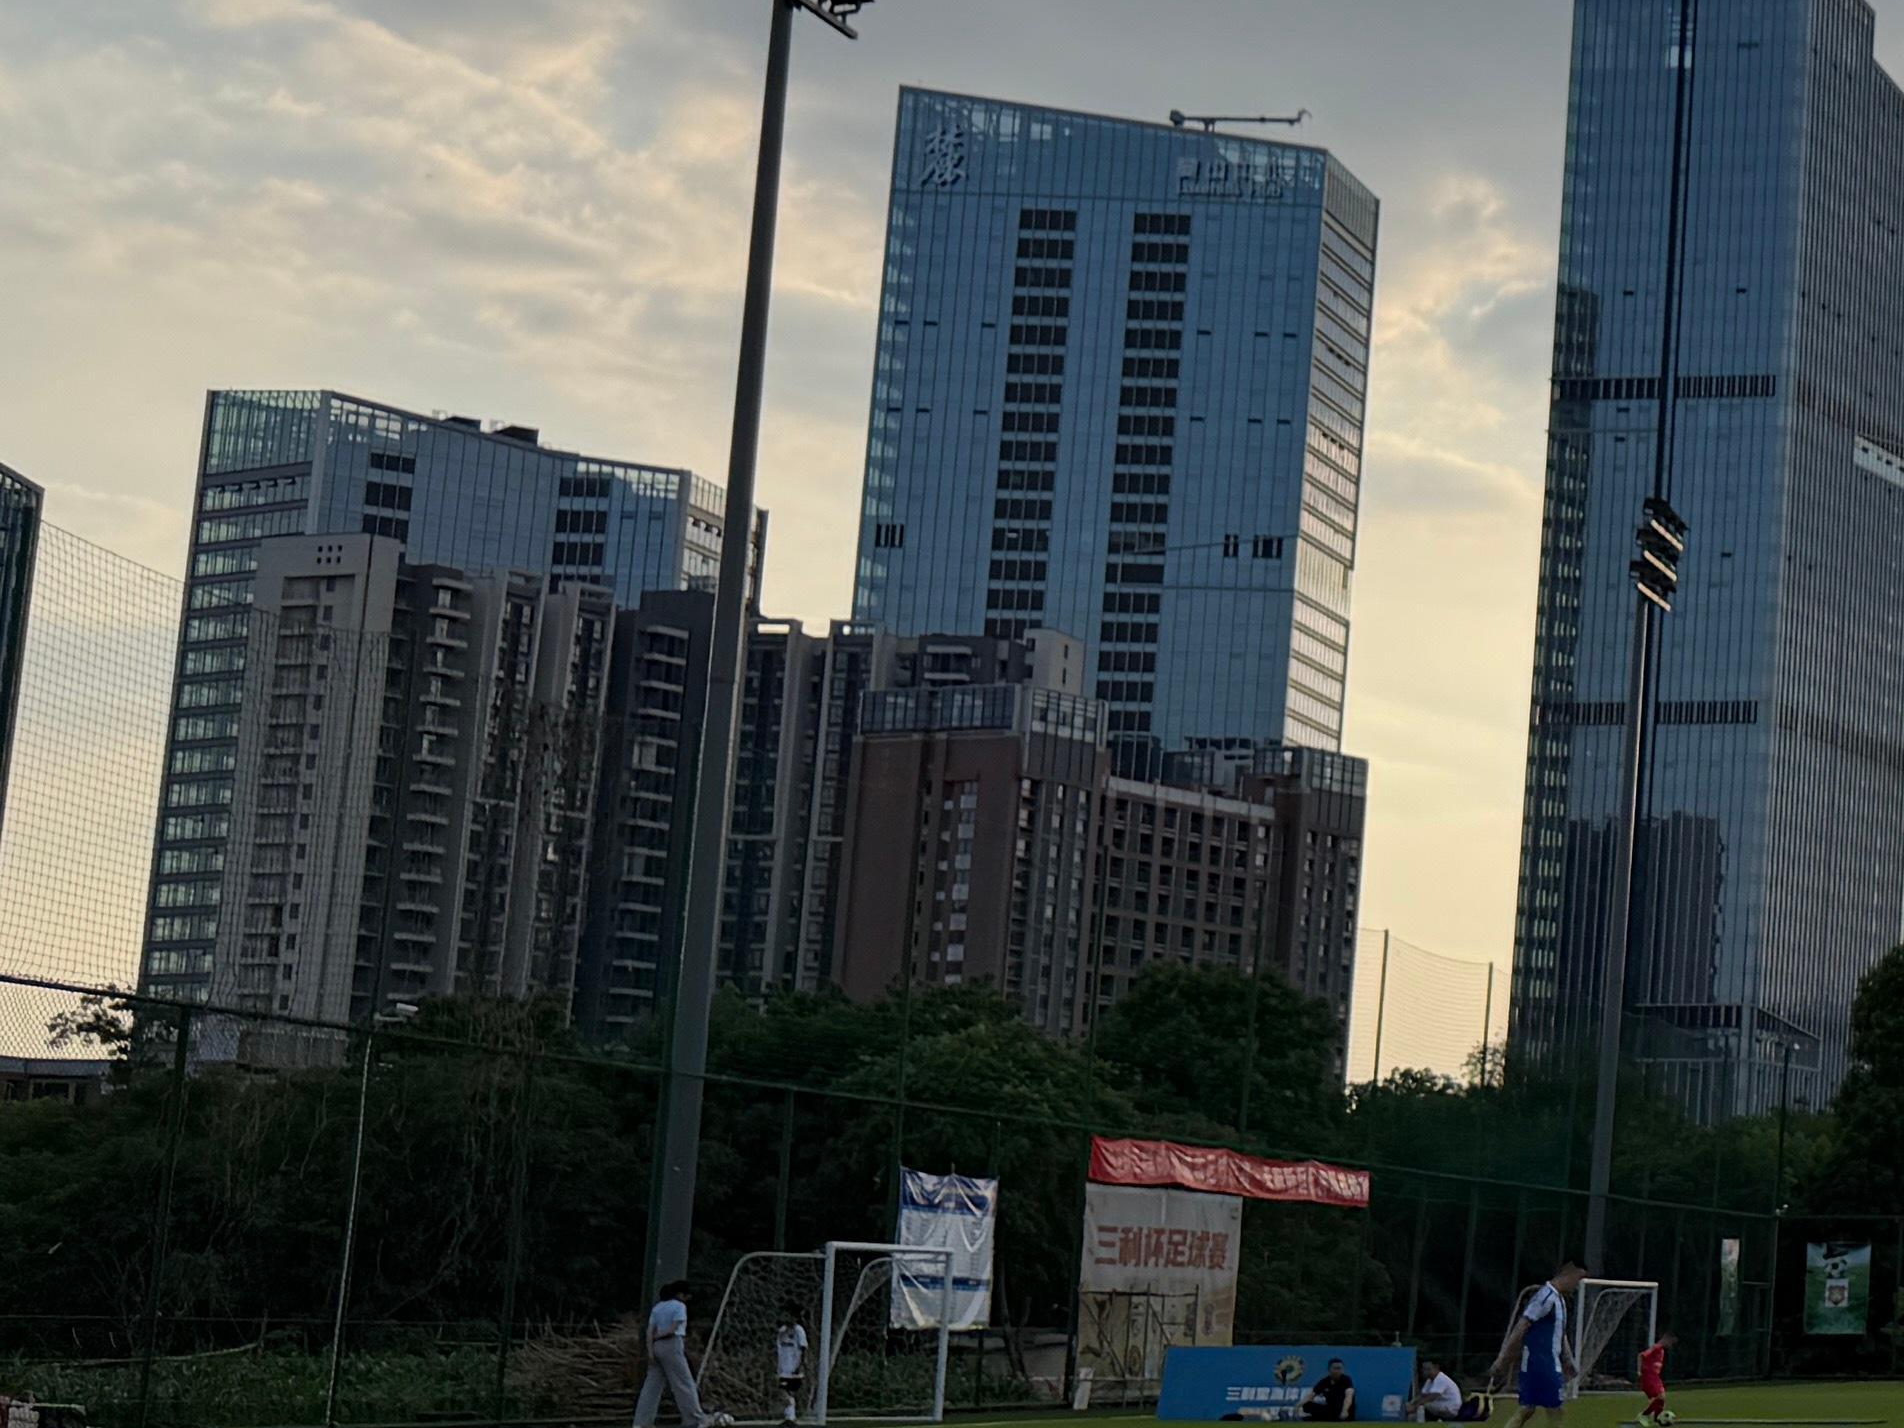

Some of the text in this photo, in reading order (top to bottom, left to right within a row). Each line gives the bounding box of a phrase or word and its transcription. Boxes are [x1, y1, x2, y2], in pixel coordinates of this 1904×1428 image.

[1094, 1226, 1229, 1269] 三利杯足球赛
